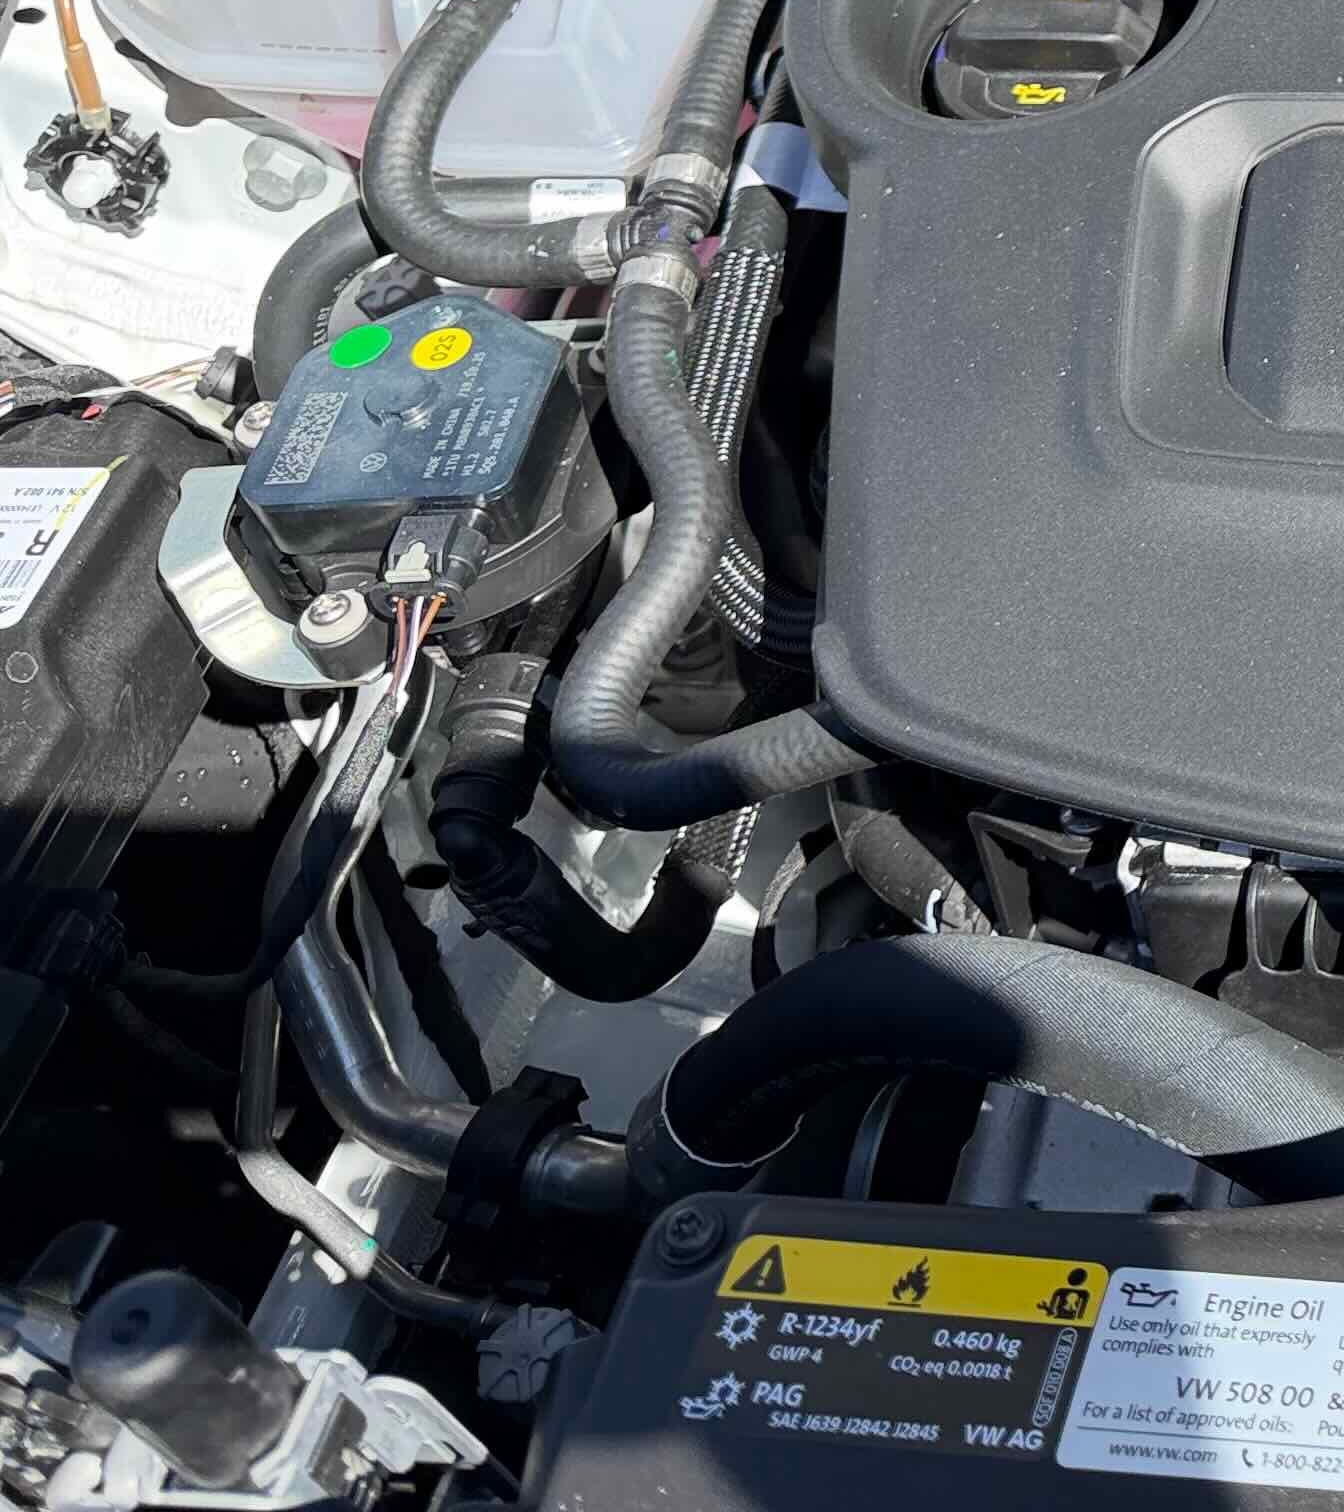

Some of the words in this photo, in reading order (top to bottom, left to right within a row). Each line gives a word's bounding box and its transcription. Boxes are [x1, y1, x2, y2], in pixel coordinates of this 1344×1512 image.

[1204, 1293, 1284, 1321] Engine
[1290, 1300, 1325, 1321] Oil
[778, 1312, 883, 1347] R-1234yf
[934, 1328, 994, 1352] 0.460
[996, 1333, 1021, 1358] kg
[1109, 1315, 1139, 1333] Use
[1142, 1319, 1178, 1337] only
[1180, 1322, 1200, 1336] oil
[1203, 1323, 1237, 1339] that
[1240, 1328, 1316, 1348] expressly
[768, 1345, 808, 1362] GWP
[811, 1349, 823, 1363] 4
[924, 1362, 944, 1379] eq
[1102, 1337, 1174, 1358] complies
[1178, 1342, 1215, 1358] with
[751, 1380, 805, 1407] PAG
[1176, 1377, 1221, 1401] VW
[1226, 1381, 1274, 1405] 508
[1280, 1385, 1315, 1408] 00
[768, 1411, 800, 1429] SAE
[963, 1424, 1006, 1446] VW
[1008, 1429, 1045, 1449] AG
[1082, 1401, 1110, 1418] For
[1112, 1406, 1122, 1419] a
[1126, 1404, 1151, 1421] list
[1154, 1406, 1174, 1423] of
[1176, 1409, 1256, 1429] approved
[1259, 1416, 1294, 1433] oils:
[1109, 1442, 1217, 1463] www.vw.com
